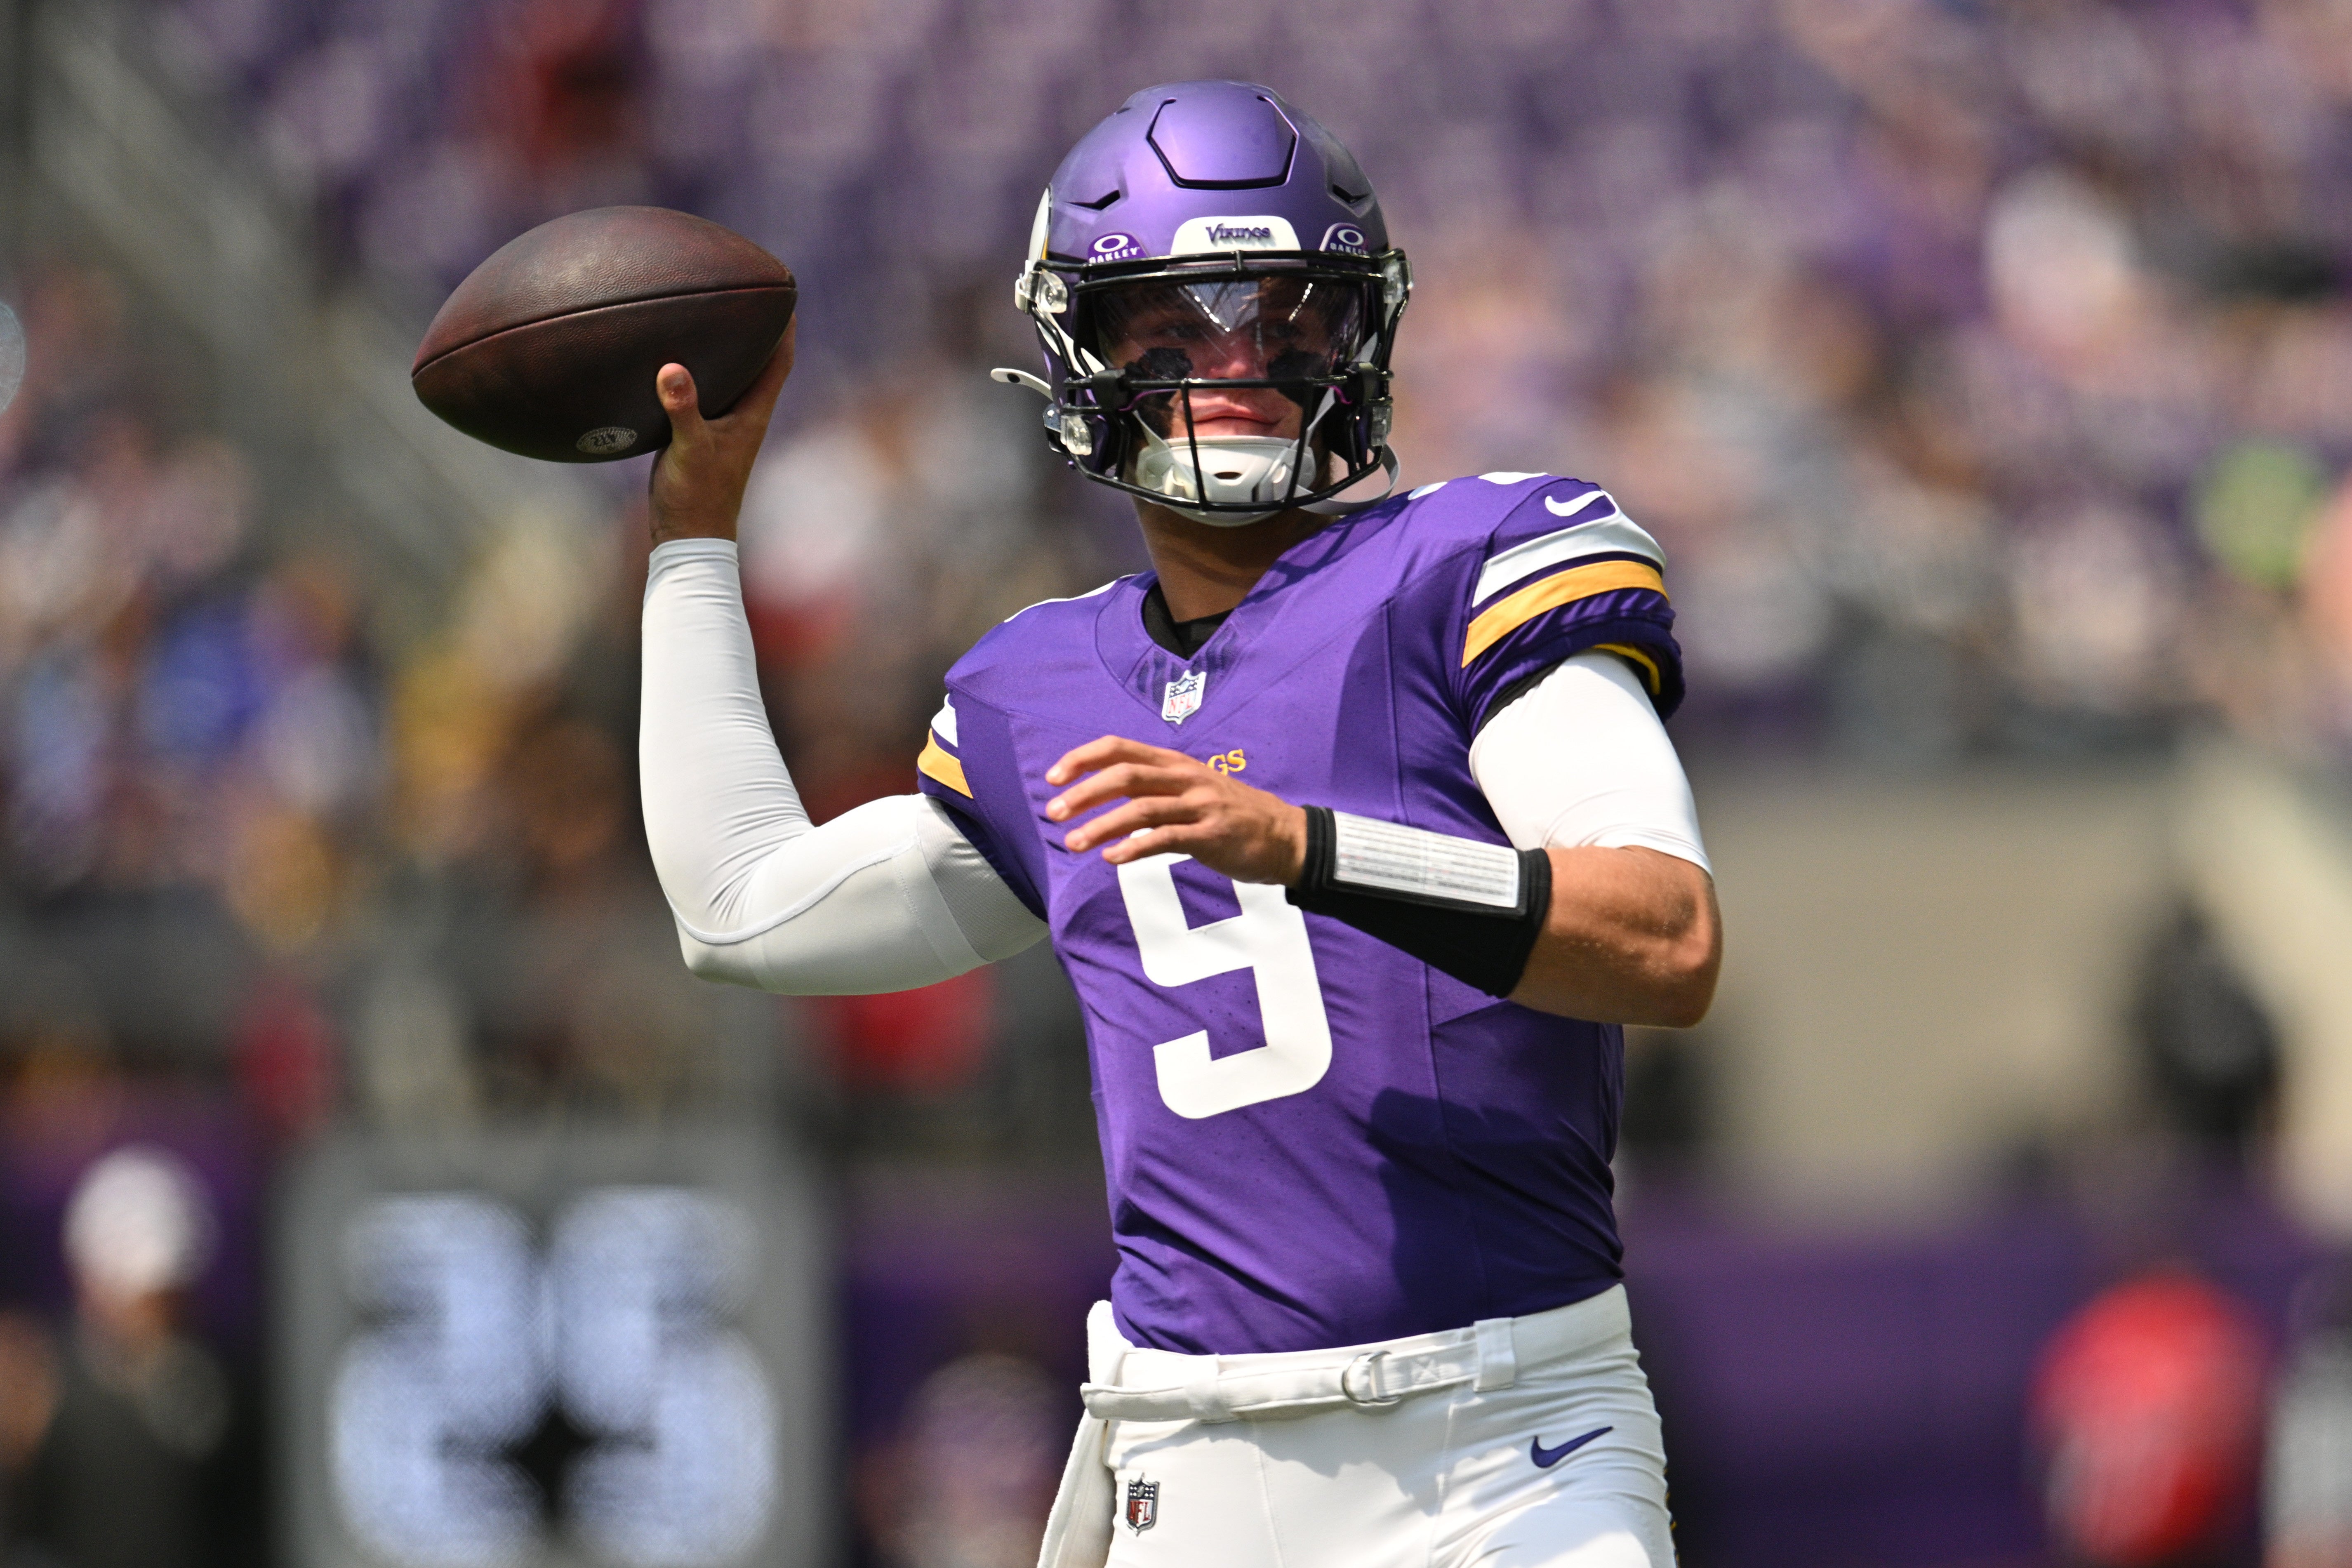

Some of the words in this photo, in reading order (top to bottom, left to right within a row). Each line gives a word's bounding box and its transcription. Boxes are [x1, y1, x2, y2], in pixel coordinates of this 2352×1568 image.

[1088, 247, 1138, 264] OAKLEY
[1168, 693, 1193, 714] NFL
[1117, 827, 1333, 1119] 9
[1129, 1500, 1152, 1524] NFL
